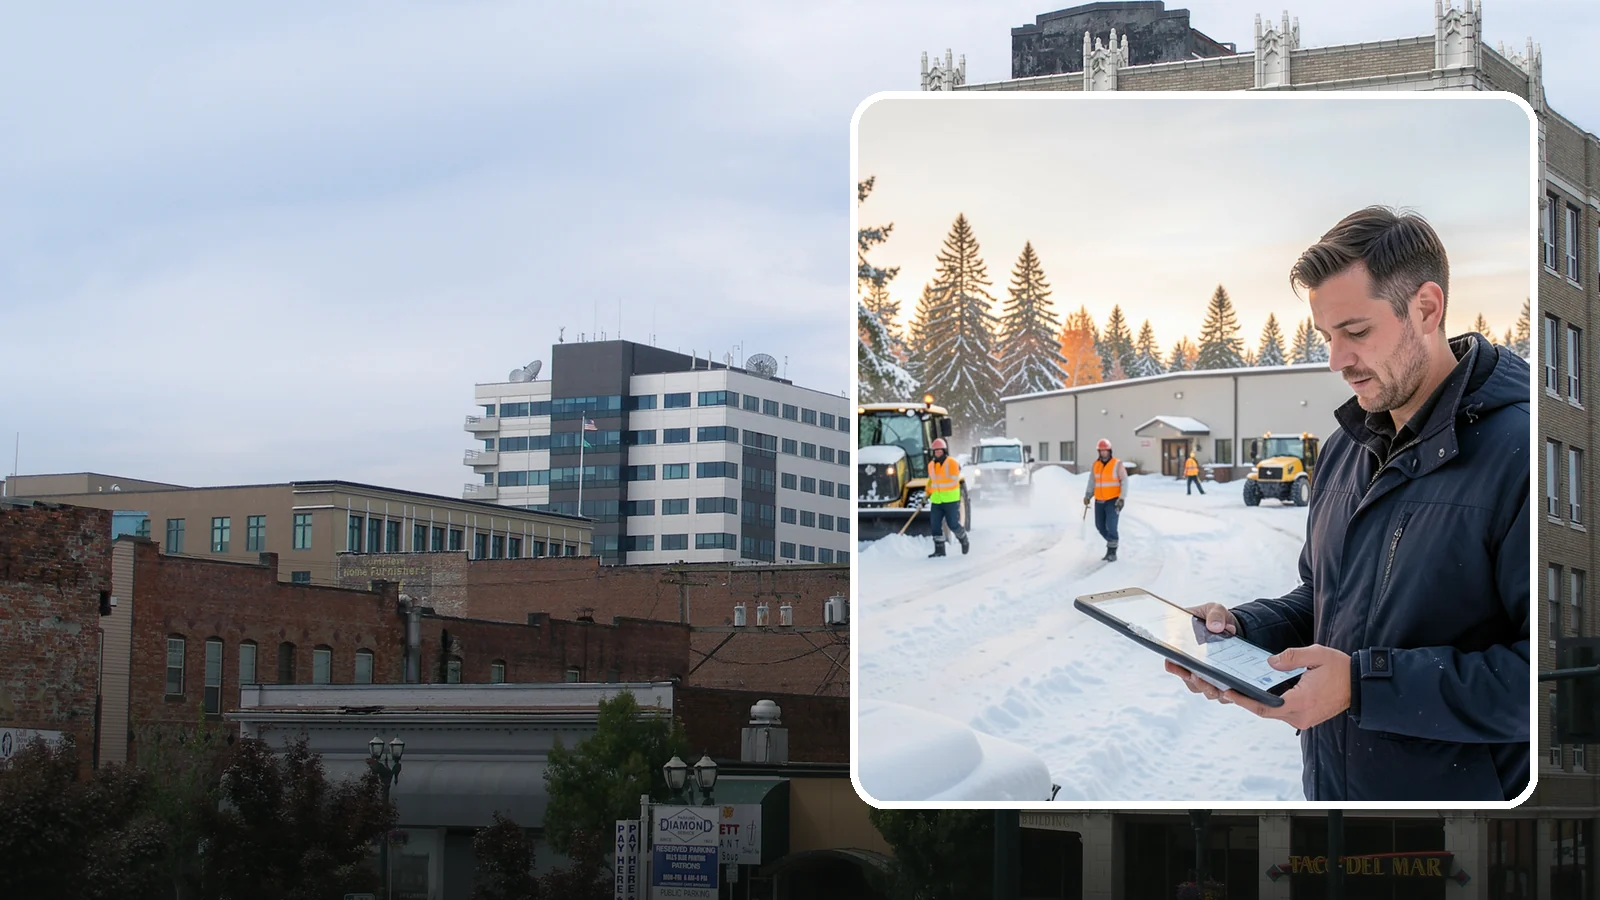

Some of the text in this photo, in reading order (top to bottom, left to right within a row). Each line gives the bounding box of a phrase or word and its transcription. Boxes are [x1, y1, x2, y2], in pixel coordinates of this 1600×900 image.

[370, 566, 427, 576] Furnishers
[660, 818, 713, 832] DIAMOND
[1023, 815, 1069, 827] BUILDING
[720, 824, 740, 835] ETT
[719, 839, 739, 848] ANT
[690, 846, 716, 854] PARKING
[722, 852, 739, 862] Soup
[1289, 855, 1442, 877] TAC DEL MAR
[628, 856, 636, 893] HERE
[684, 890, 710, 898] PARKING
